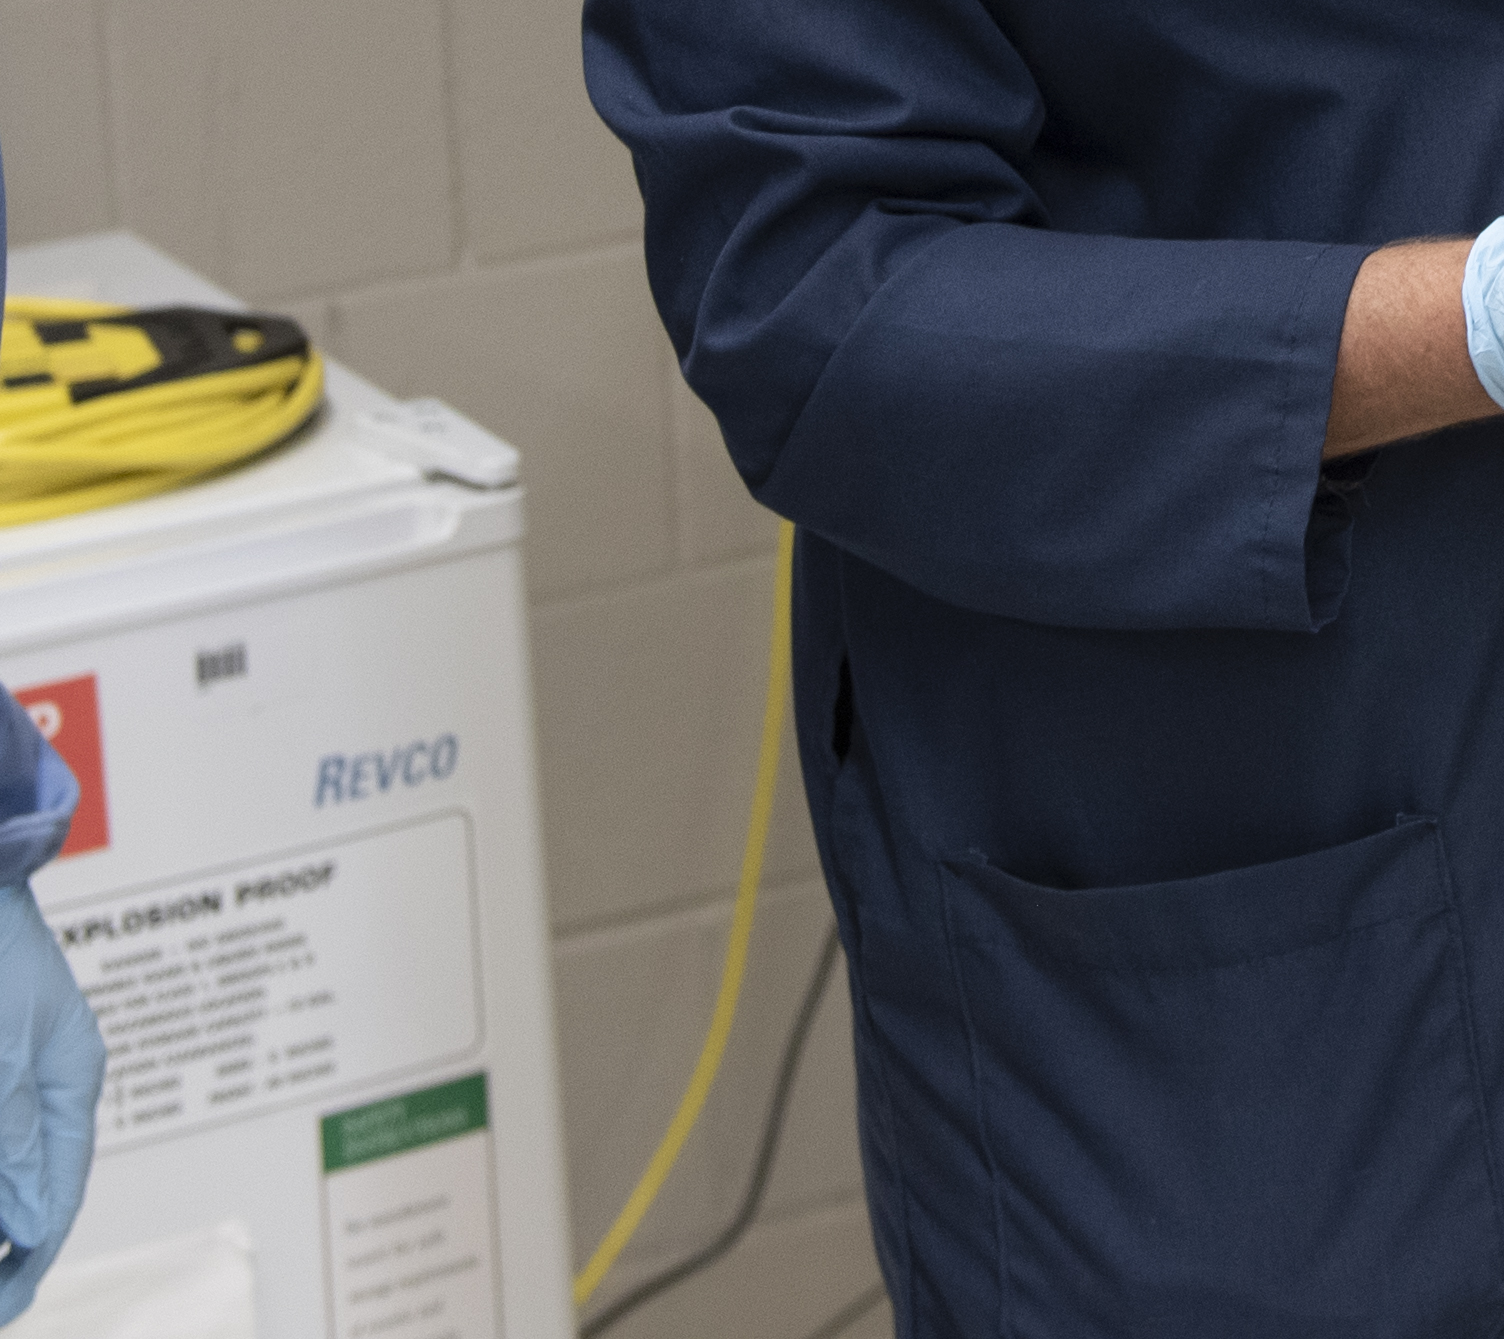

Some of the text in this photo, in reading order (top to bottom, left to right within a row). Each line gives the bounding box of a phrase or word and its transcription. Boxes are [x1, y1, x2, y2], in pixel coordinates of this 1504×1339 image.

[312, 731, 461, 811] REVCO
[55, 888, 225, 953] XPLOSION
[234, 857, 337, 908] PROOF
